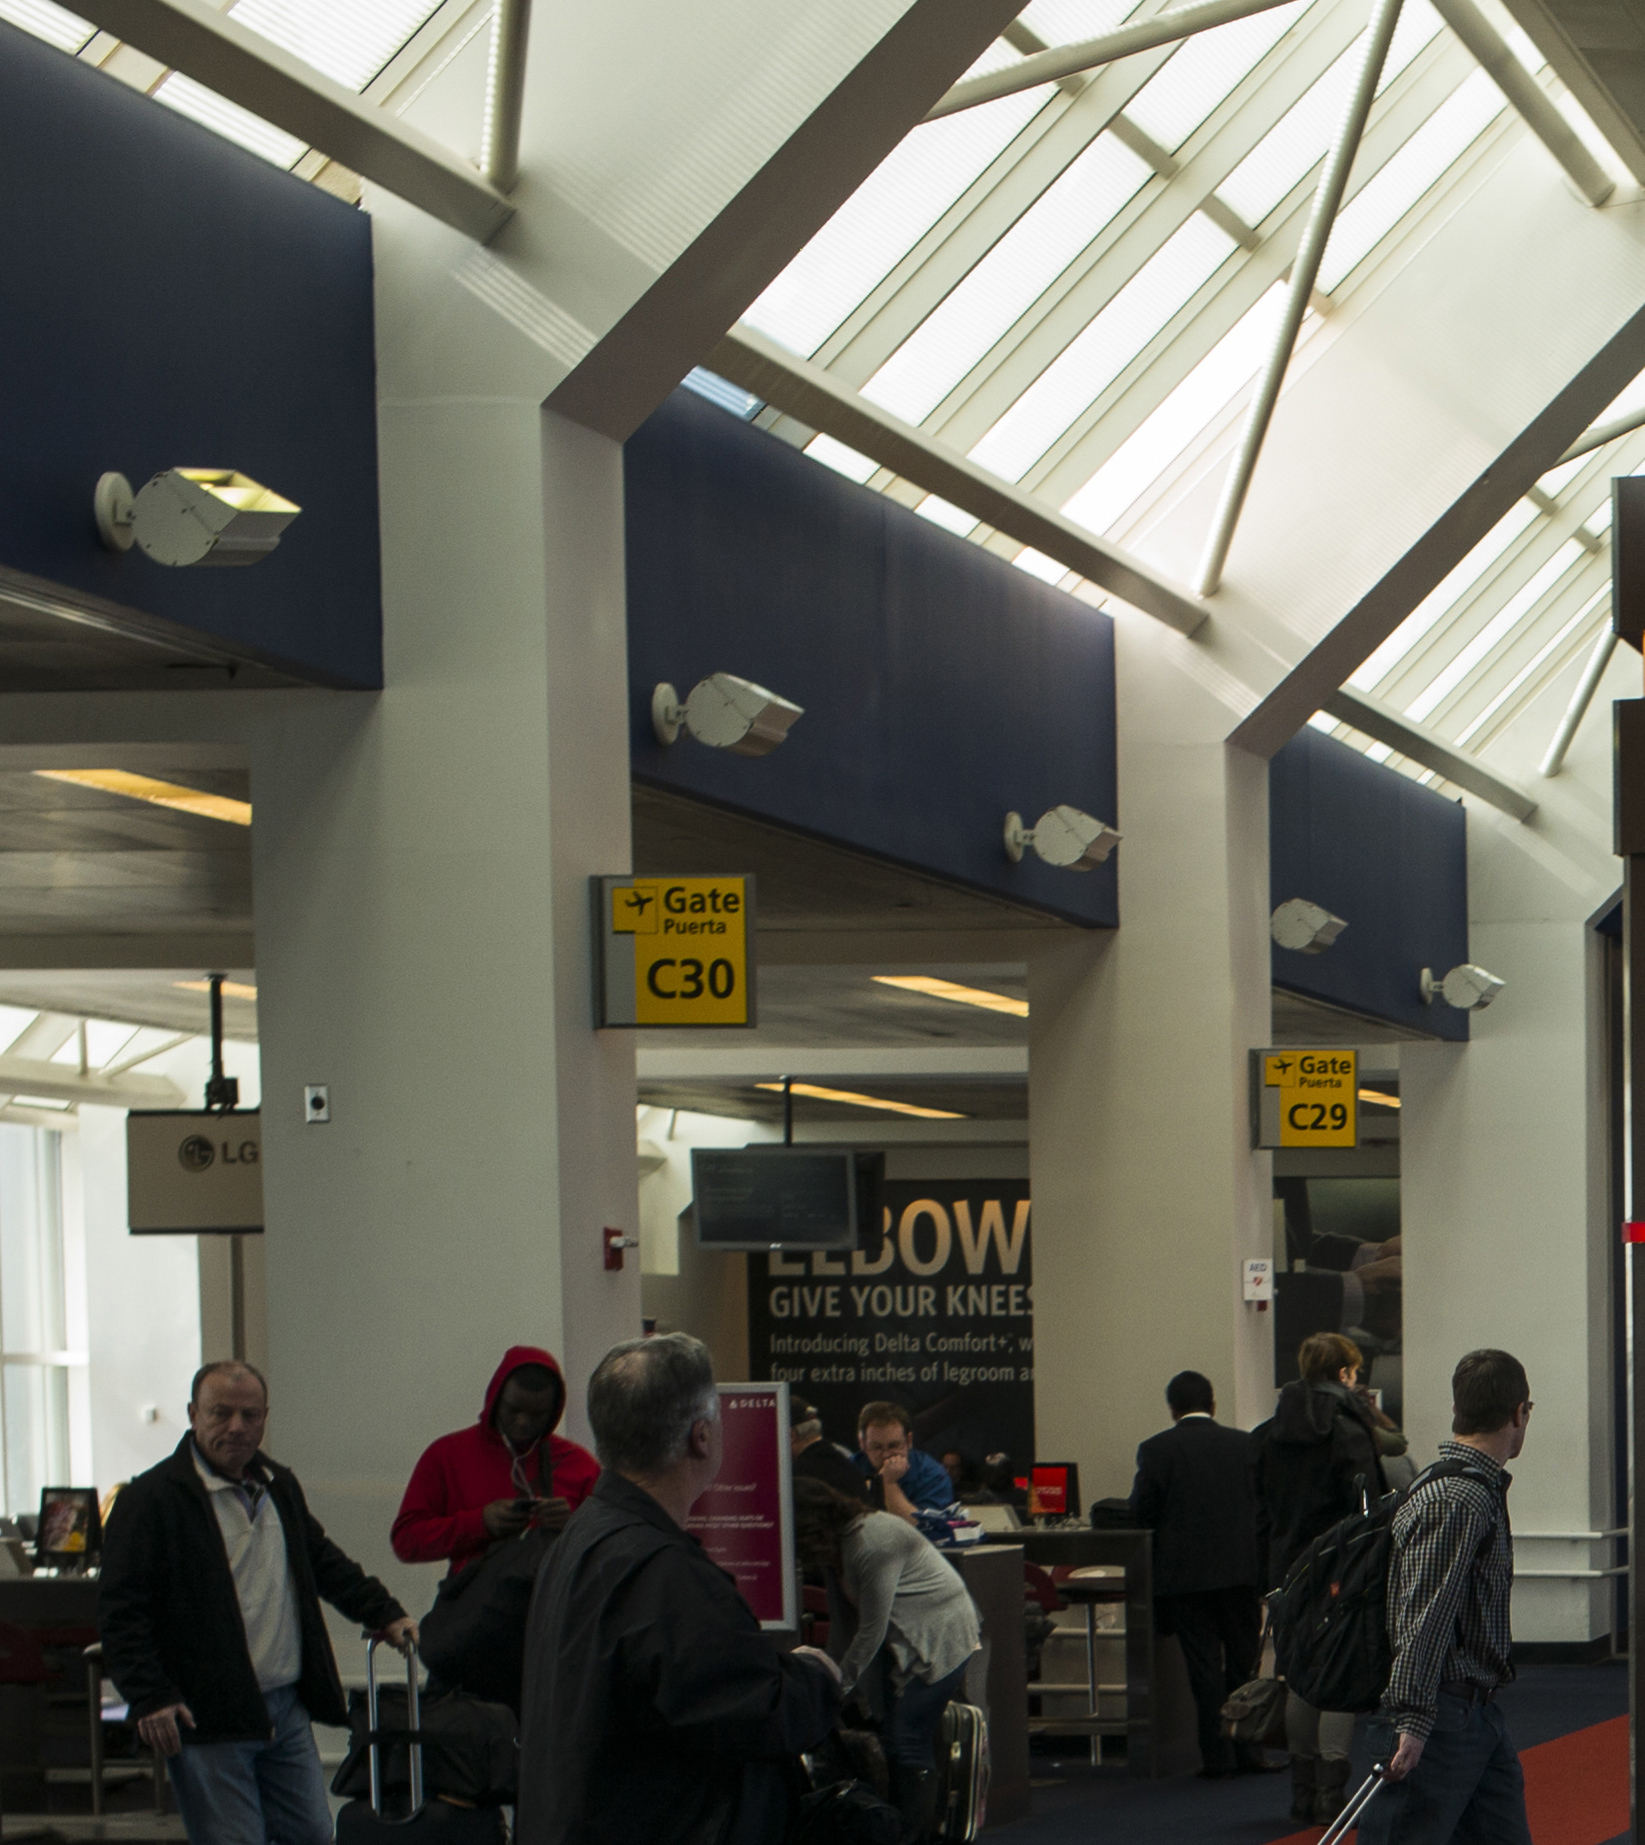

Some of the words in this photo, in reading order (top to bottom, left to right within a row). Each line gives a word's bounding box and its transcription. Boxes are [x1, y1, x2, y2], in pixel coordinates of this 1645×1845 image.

[664, 886, 740, 914] Gate
[664, 918, 726, 935] Puerta
[647, 958, 735, 999] C30
[1300, 1056, 1352, 1074] Gate
[1299, 1077, 1342, 1088] Puerta
[1288, 1103, 1347, 1131] C29
[222, 1141, 259, 1164] LG
[769, 1285, 842, 1318] GIVE
[850, 1285, 937, 1317] YOUR
[770, 1332, 870, 1356] Introducing
[875, 1332, 920, 1352] Delta
[1018, 1337, 1034, 1352] w
[770, 1362, 805, 1382] four
[811, 1363, 856, 1382] extra
[860, 1361, 916, 1382] inches
[921, 1361, 939, 1382] of
[943, 1362, 1014, 1386] legroom
[739, 1398, 775, 1408] DELTA
